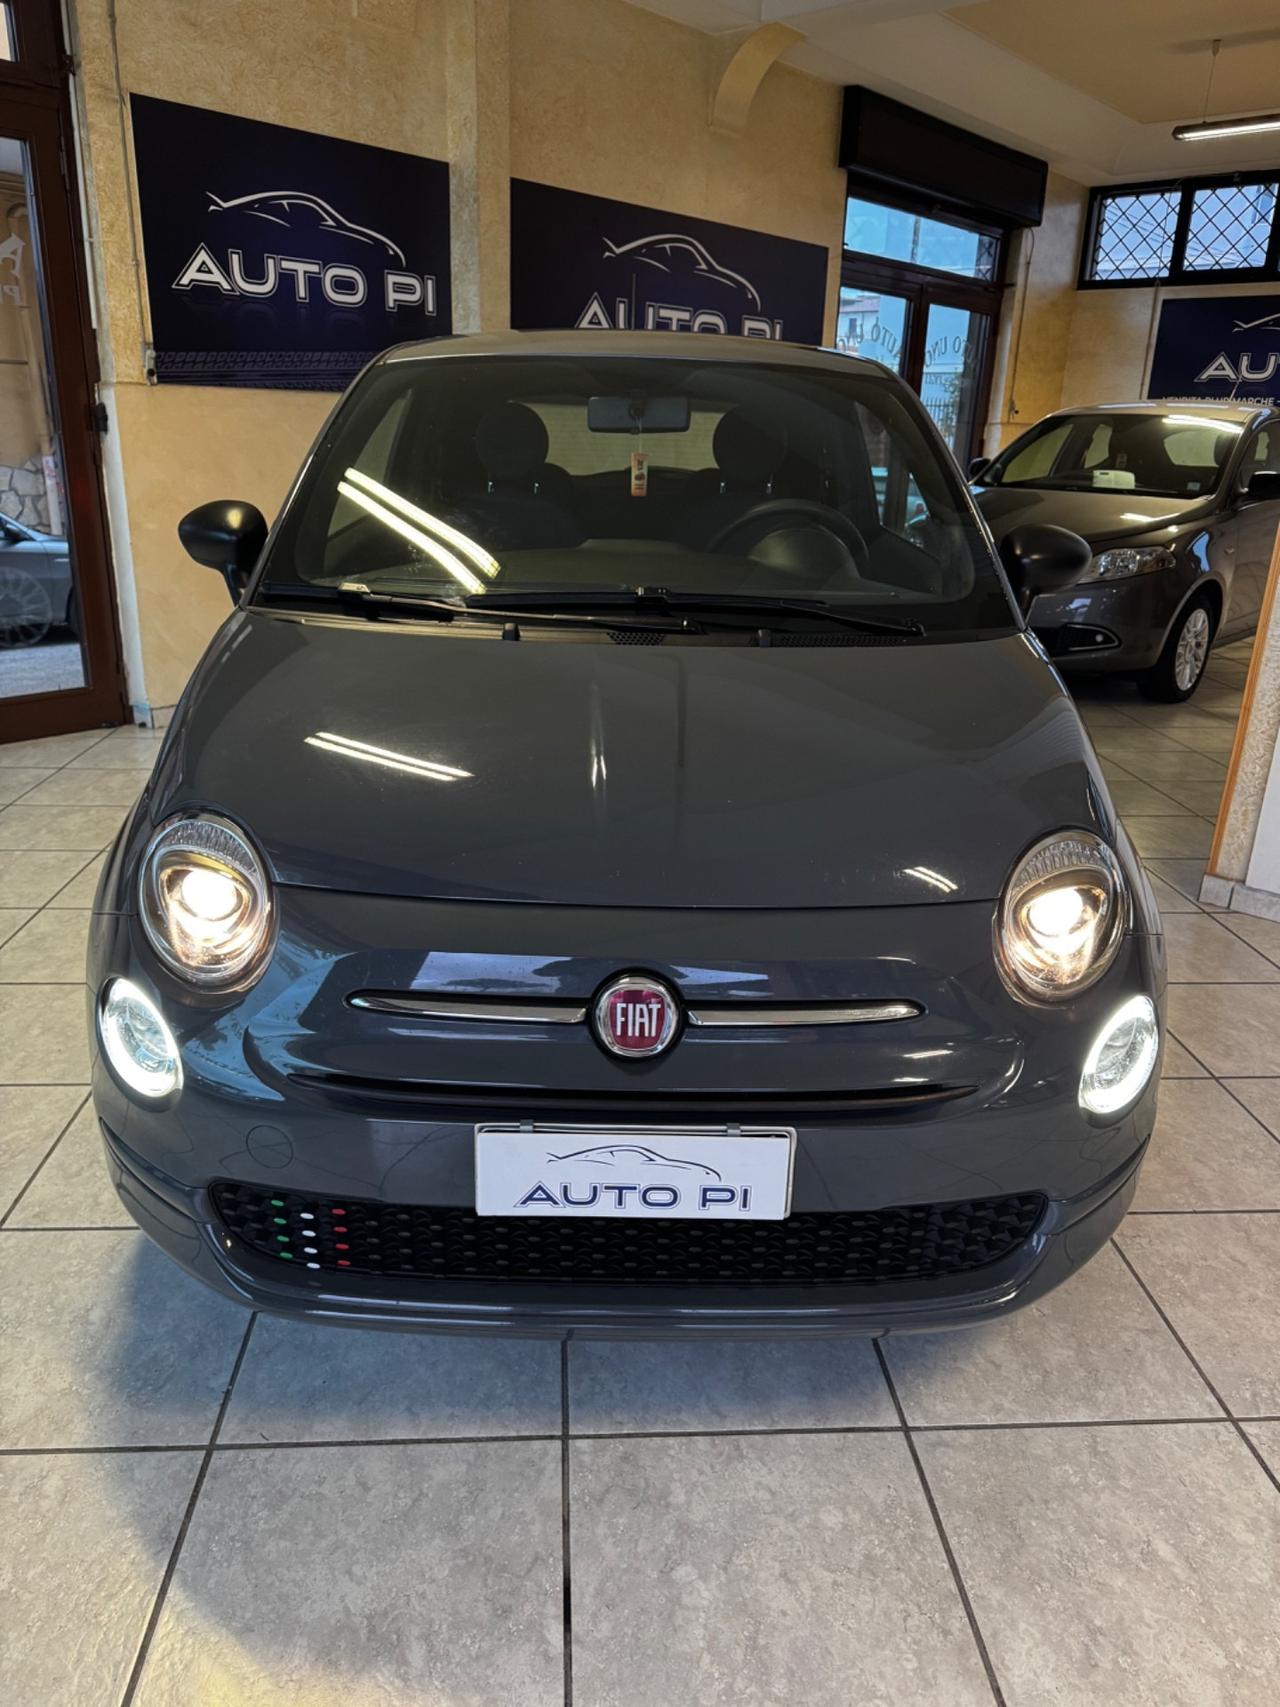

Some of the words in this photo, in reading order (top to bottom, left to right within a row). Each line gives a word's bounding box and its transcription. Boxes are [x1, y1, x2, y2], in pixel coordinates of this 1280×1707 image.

[172, 242, 367, 308] AUTO
[384, 270, 437, 316] PI
[575, 292, 728, 335] AUTO
[1194, 352, 1280, 382] AU
[616, 1003, 661, 1037] FIAT
[514, 1180, 681, 1209] AUTO
[699, 1184, 752, 1211] PI
